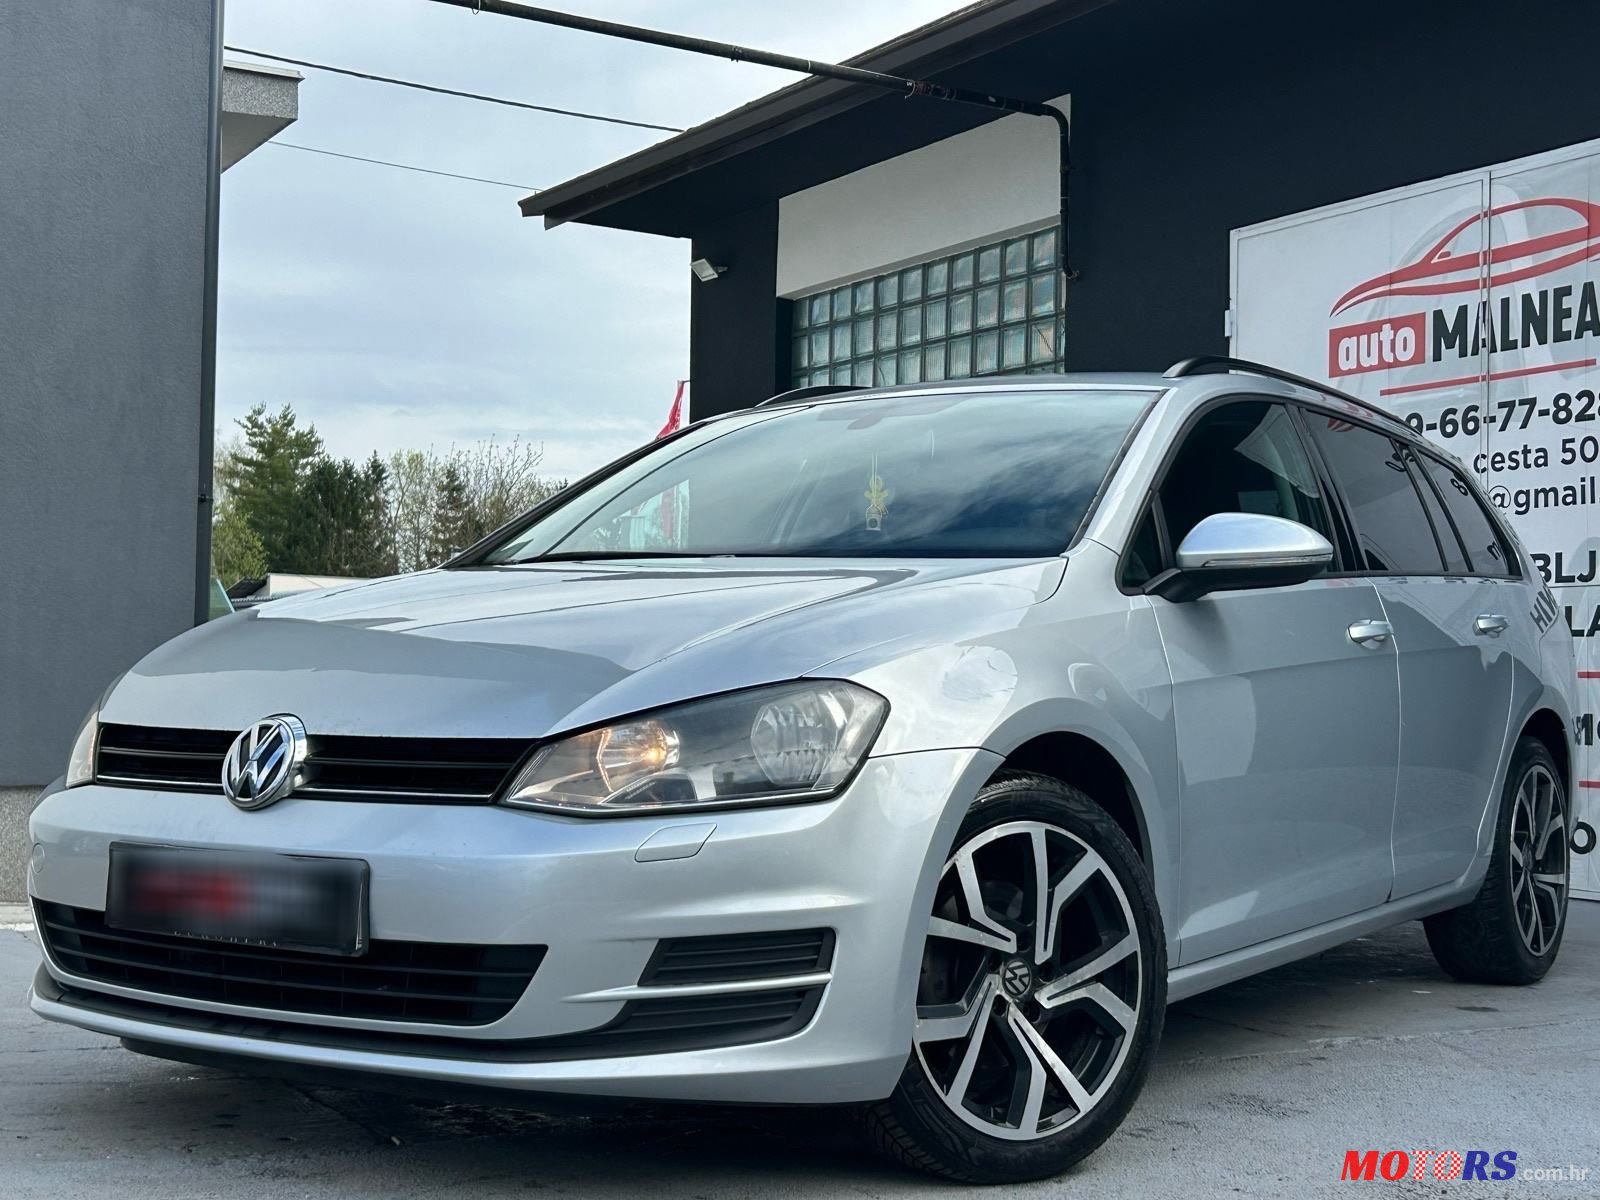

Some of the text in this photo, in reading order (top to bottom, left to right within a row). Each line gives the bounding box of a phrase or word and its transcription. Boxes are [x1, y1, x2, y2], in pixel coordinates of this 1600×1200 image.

[1338, 281, 1600, 371] auto MALNEA
[1405, 390, 1600, 438] 9-66-77-82
[1473, 436, 1599, 474] cesta 50
[1488, 475, 1600, 516] @gmail
